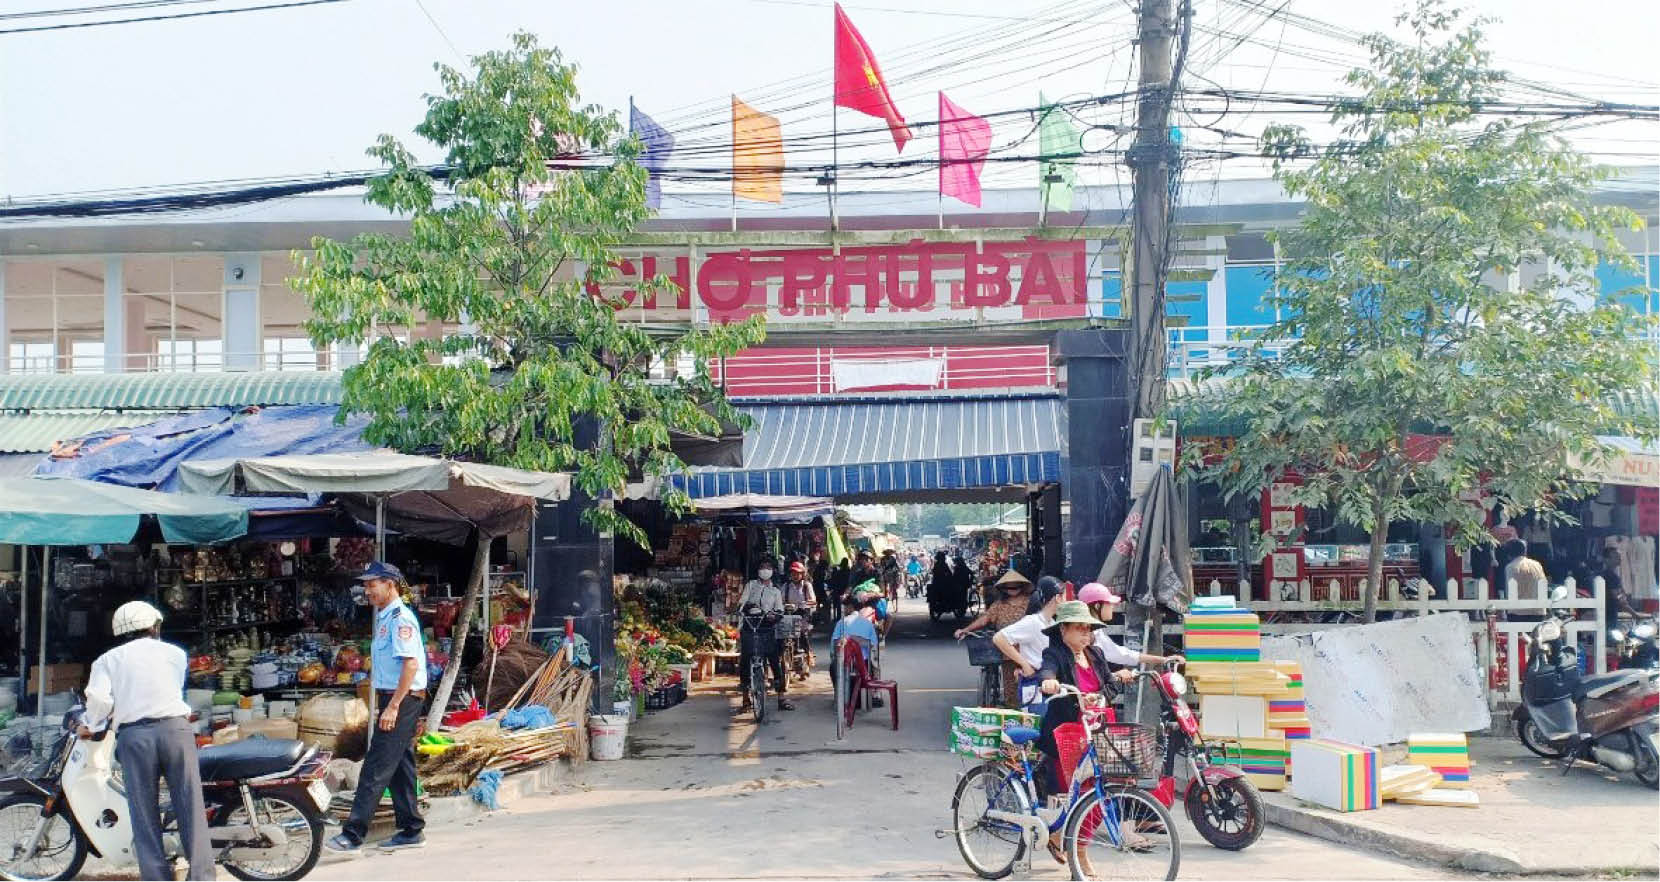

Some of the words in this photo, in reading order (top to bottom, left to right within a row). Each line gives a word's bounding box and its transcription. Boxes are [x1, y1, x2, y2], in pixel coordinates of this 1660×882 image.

[585, 248, 751, 325] CHỢ
[783, 238, 933, 309] PHÚ
[964, 235, 1087, 308] BÀI
